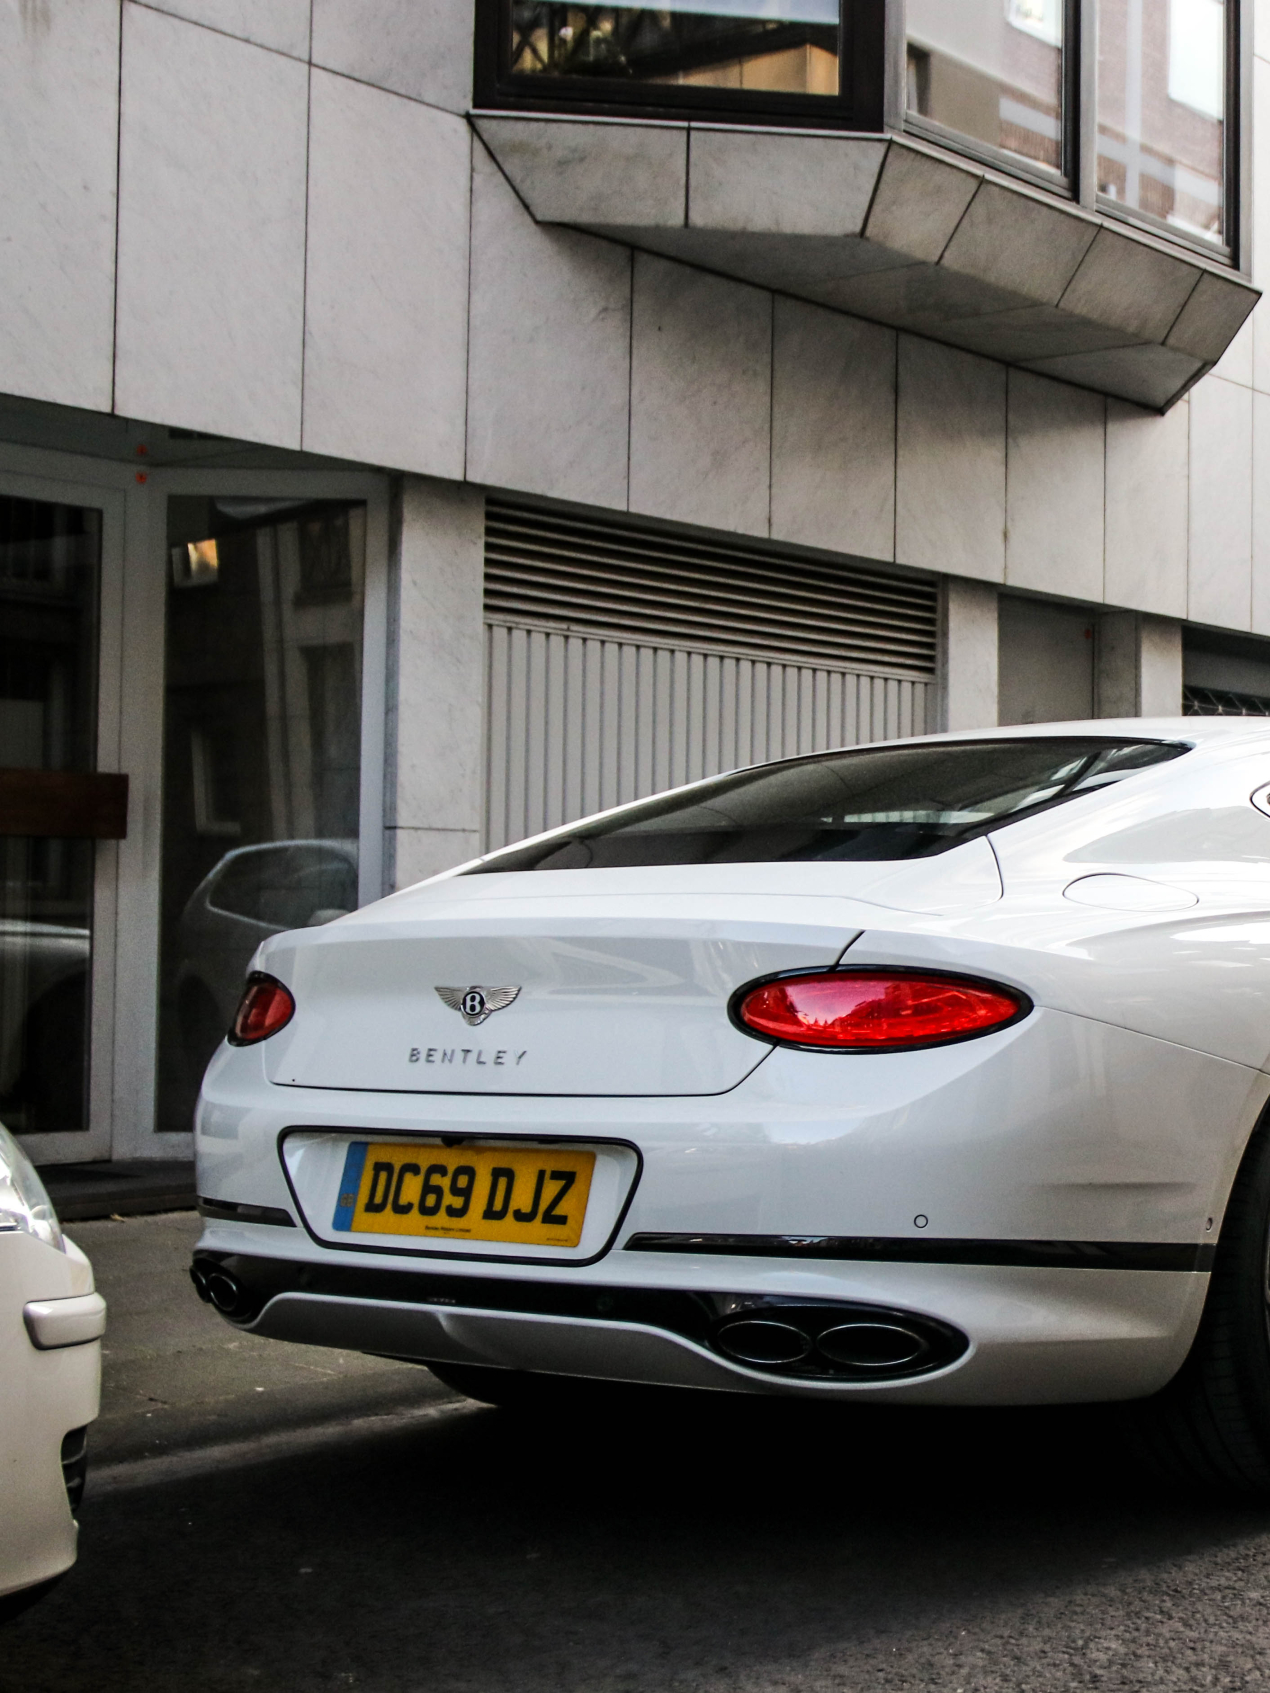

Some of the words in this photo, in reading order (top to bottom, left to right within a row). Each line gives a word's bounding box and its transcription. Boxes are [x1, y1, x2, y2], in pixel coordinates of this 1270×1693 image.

[408, 1047, 528, 1066] BENTLEY
[363, 1161, 476, 1218] DC69
[482, 1166, 577, 1226] DJZ
